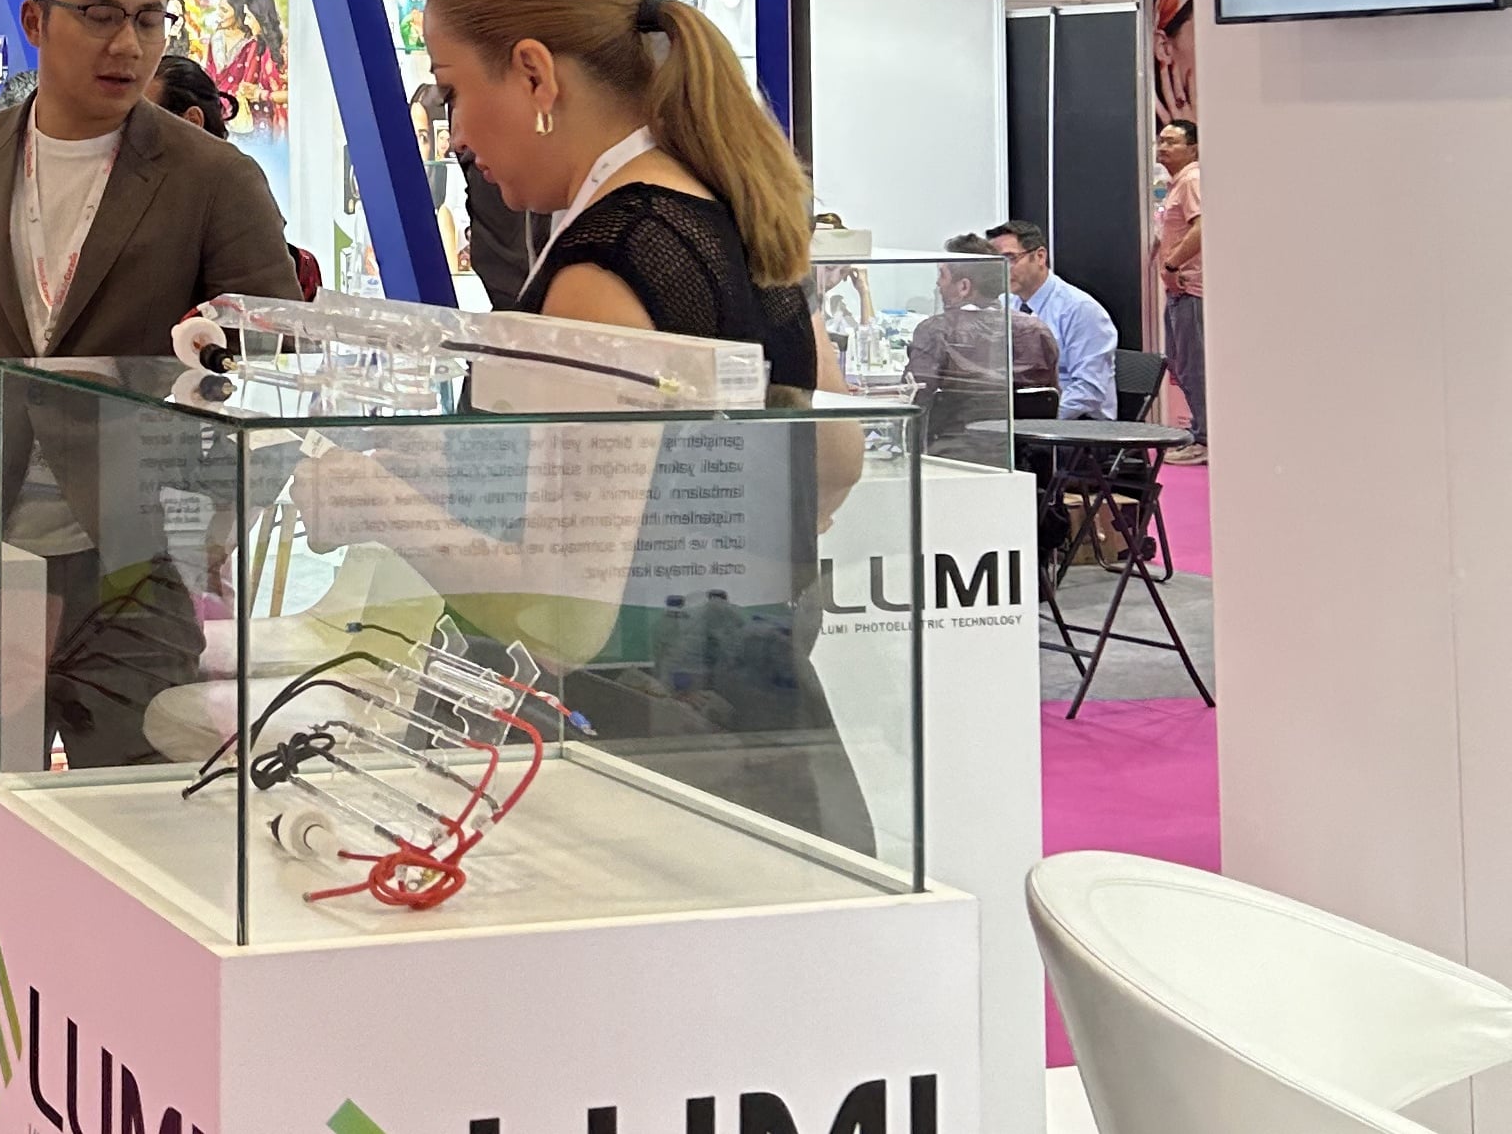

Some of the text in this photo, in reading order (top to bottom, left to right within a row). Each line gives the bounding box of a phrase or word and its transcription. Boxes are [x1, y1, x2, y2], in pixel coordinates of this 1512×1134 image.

[820, 550, 1022, 614] LUMI
[821, 623, 848, 635] LUMI
[952, 614, 1023, 628] TECHNOLOGY
[29, 985, 205, 1134] LUM
